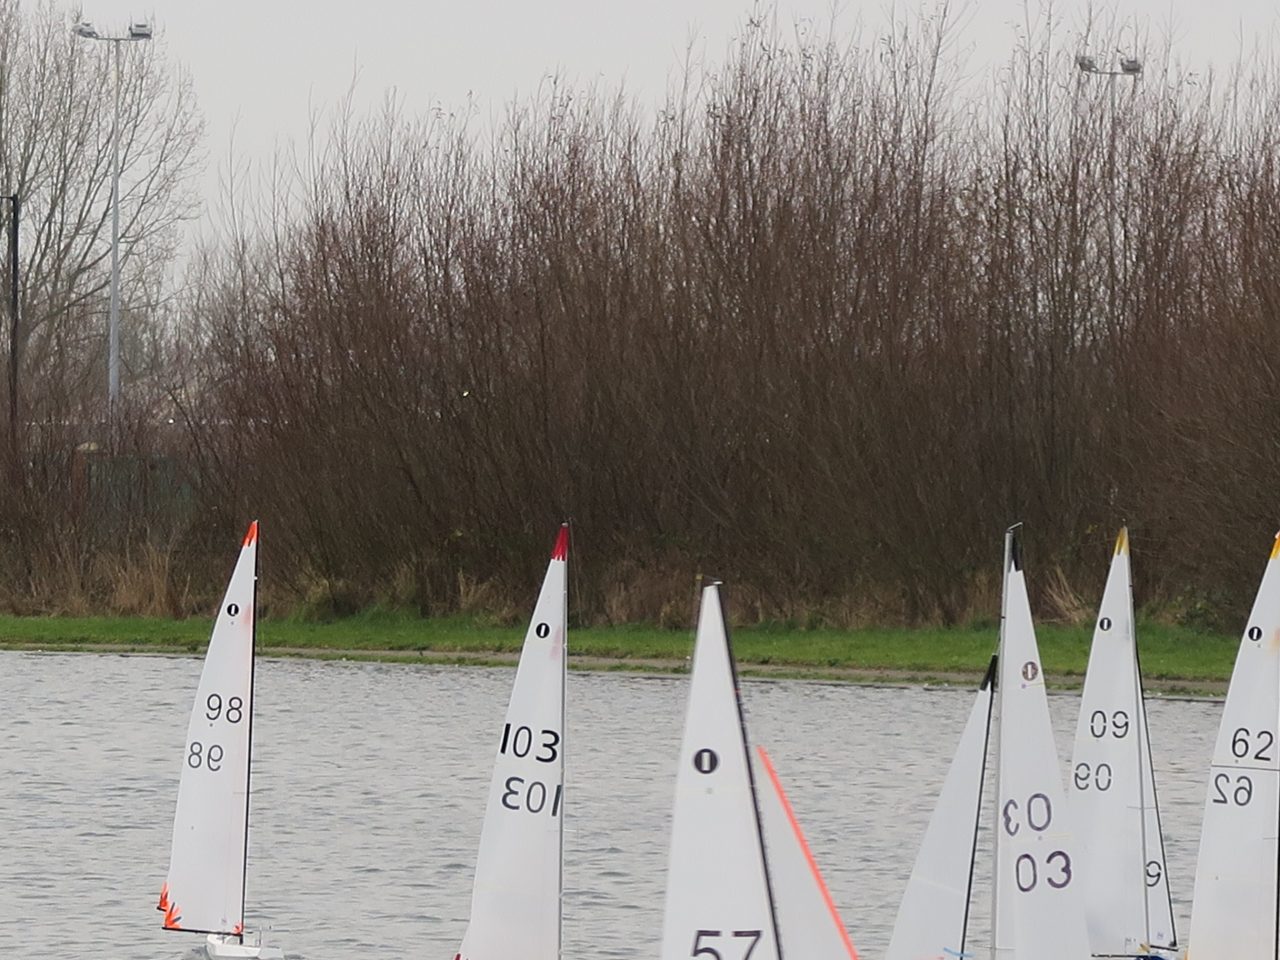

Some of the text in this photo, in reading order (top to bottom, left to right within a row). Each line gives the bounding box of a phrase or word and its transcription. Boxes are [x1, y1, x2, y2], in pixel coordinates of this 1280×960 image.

[205, 693, 243, 724] 98
[1090, 710, 1129, 739] 09
[500, 723, 561, 764] 103
[1231, 728, 1274, 762] 62
[1015, 850, 1072, 893] 03
